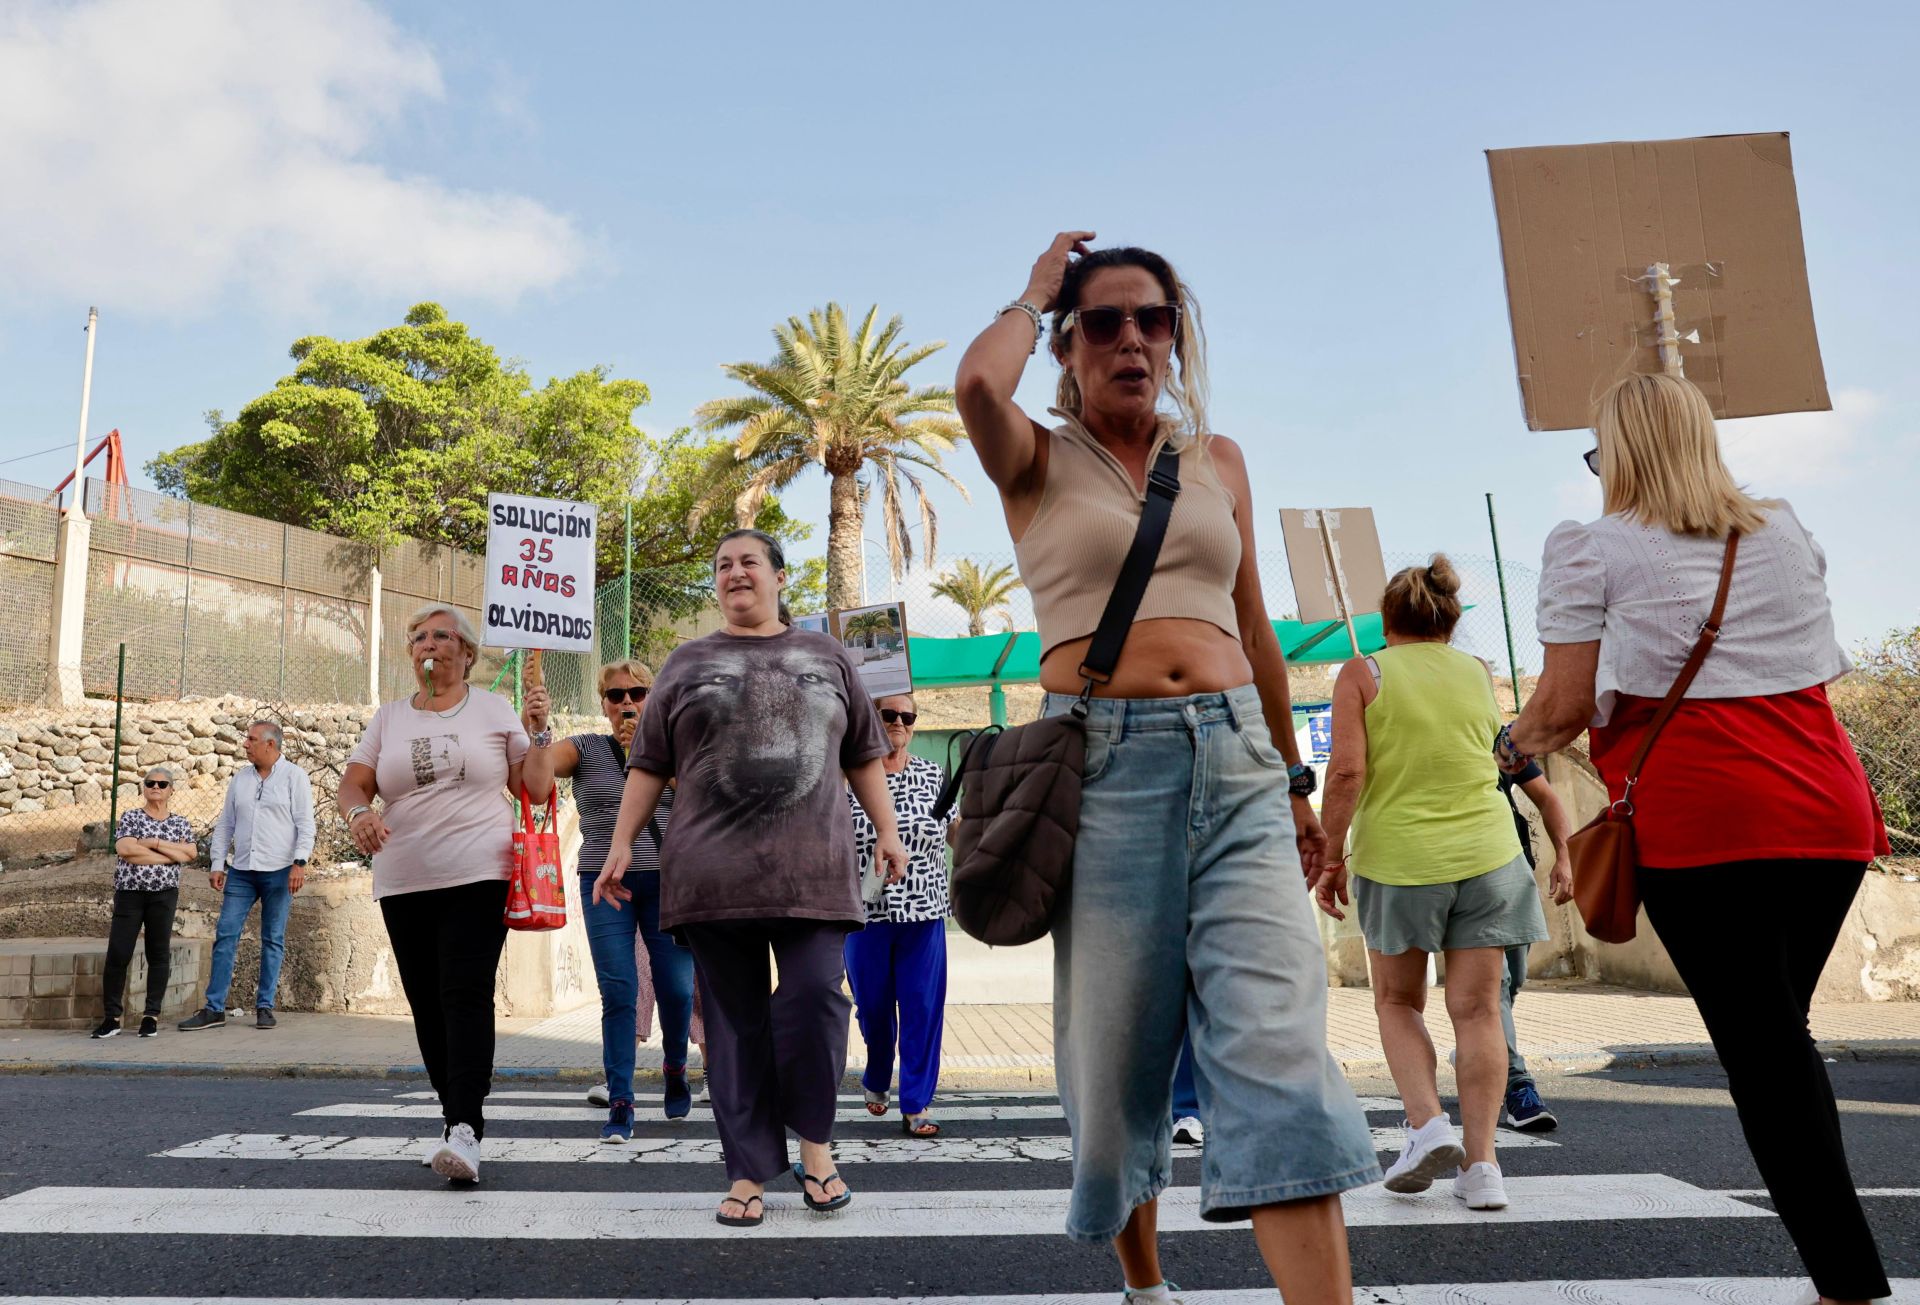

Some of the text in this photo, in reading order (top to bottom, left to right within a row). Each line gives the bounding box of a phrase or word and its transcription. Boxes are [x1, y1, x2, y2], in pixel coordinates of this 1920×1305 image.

[519, 538, 554, 563] 35
[502, 564, 576, 598] AÑOS
[488, 603, 592, 640] OLVIDADOS
